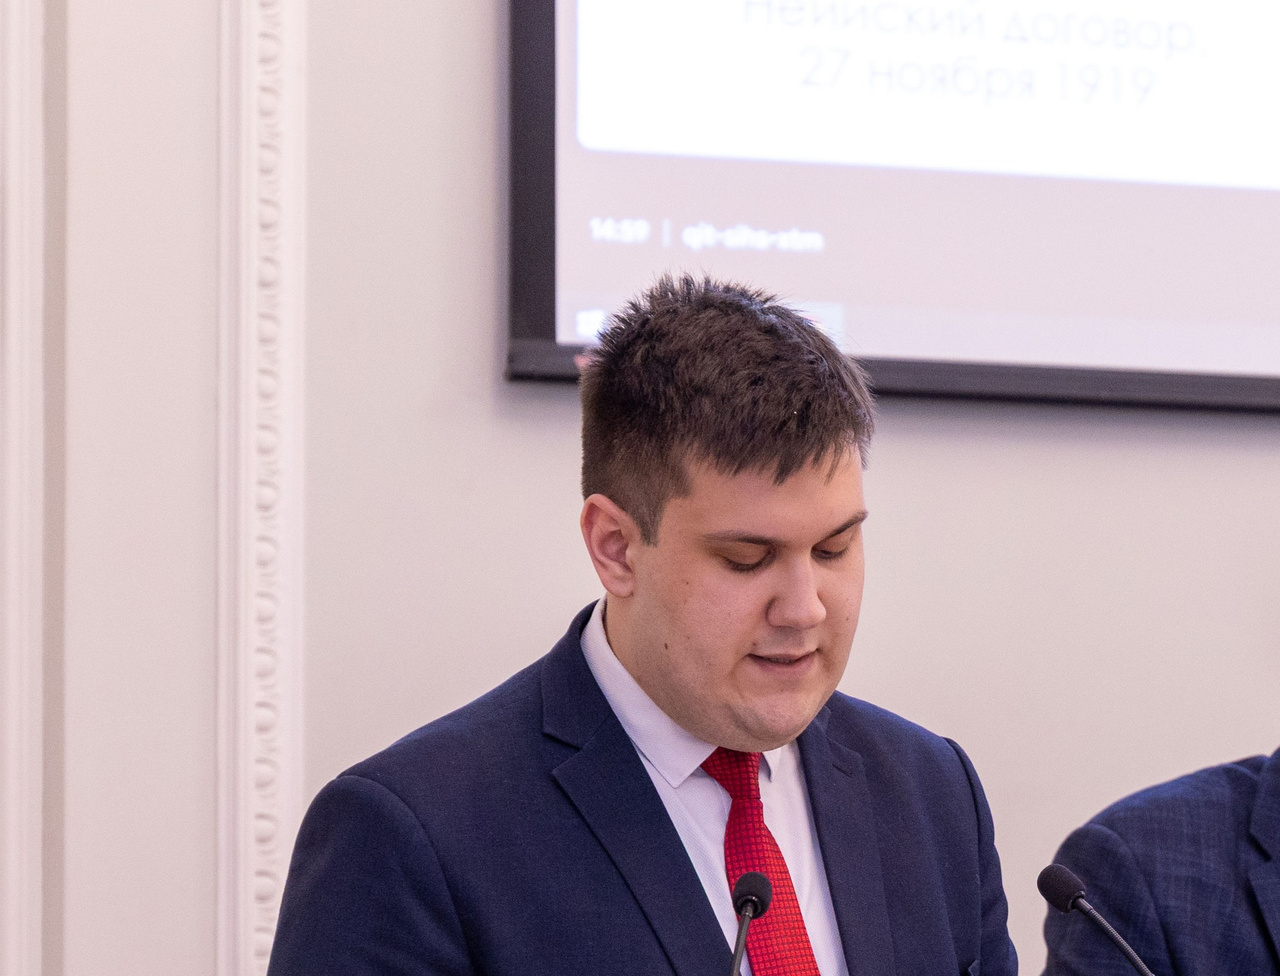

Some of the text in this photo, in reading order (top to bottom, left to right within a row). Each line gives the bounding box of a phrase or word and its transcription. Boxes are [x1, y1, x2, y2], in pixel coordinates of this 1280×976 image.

[799, 43, 1157, 109] 27 ноября 1919
